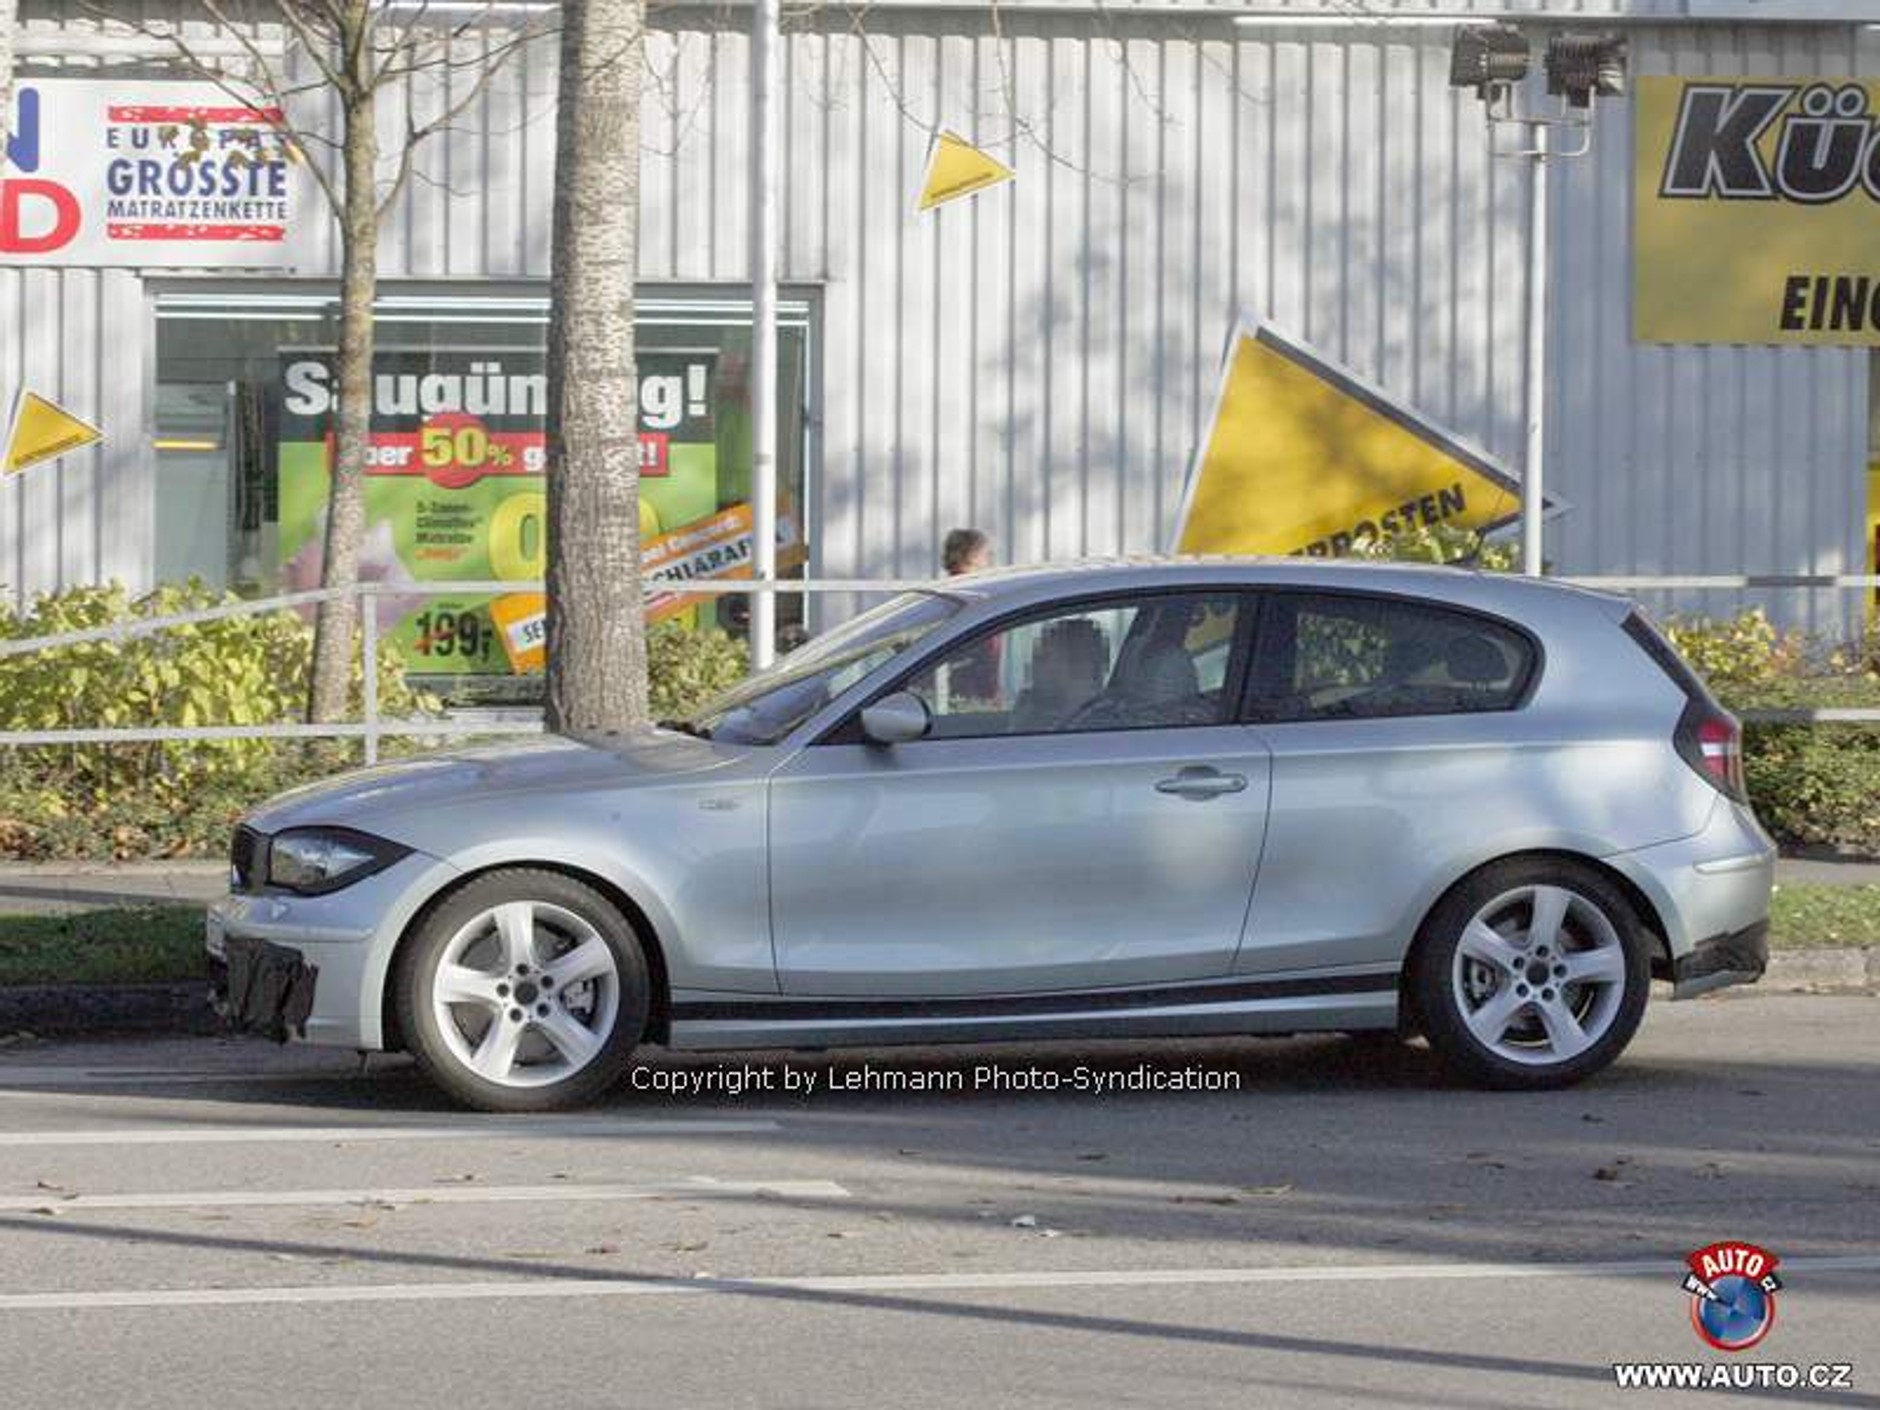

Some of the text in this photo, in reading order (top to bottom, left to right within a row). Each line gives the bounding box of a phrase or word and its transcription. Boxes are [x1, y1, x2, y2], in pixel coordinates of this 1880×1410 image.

[1658, 82, 1880, 204] Kü
[107, 200, 286, 219] MATRATZENKETTE
[421, 426, 513, 468] 50%
